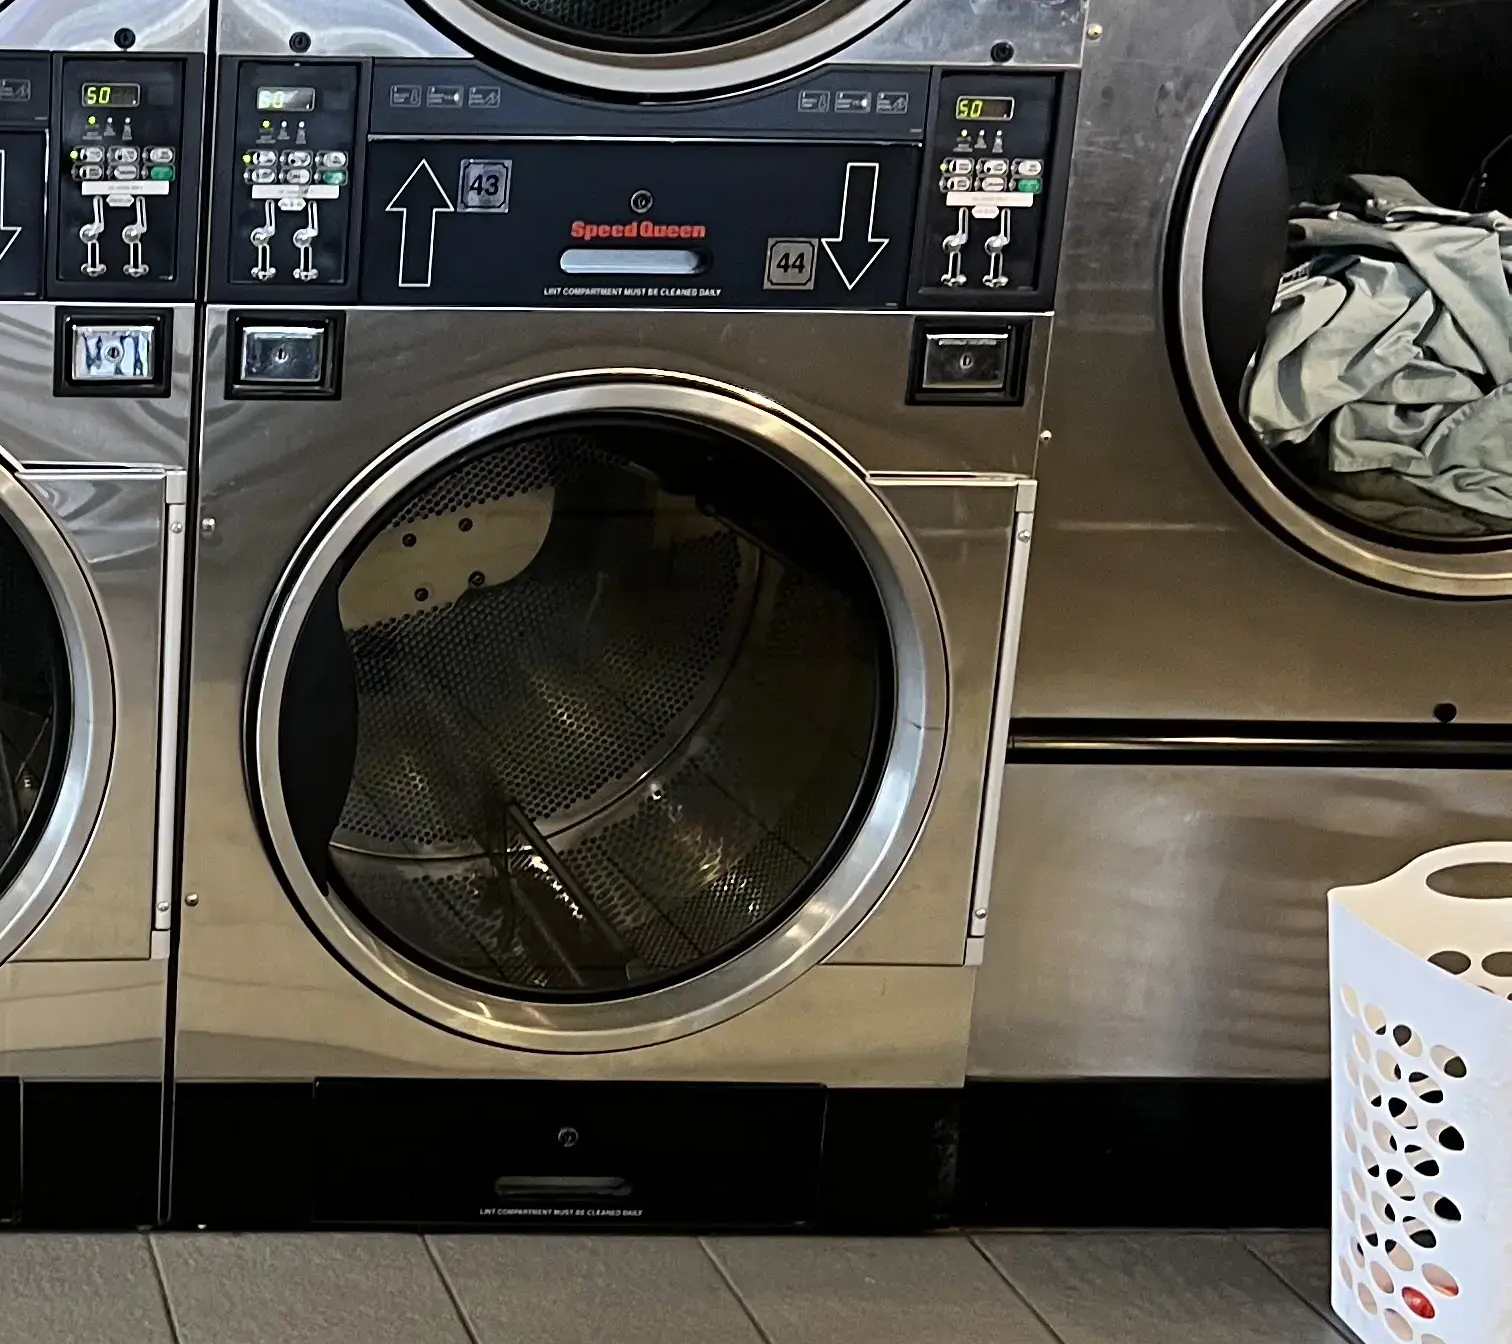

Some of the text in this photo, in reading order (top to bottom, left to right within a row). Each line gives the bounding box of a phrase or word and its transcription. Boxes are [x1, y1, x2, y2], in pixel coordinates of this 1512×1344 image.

[86, 86, 110, 105] 50
[959, 100, 983, 117] 50
[469, 174, 500, 197] 43
[571, 220, 706, 241] Speed Queen
[775, 251, 806, 274] 44
